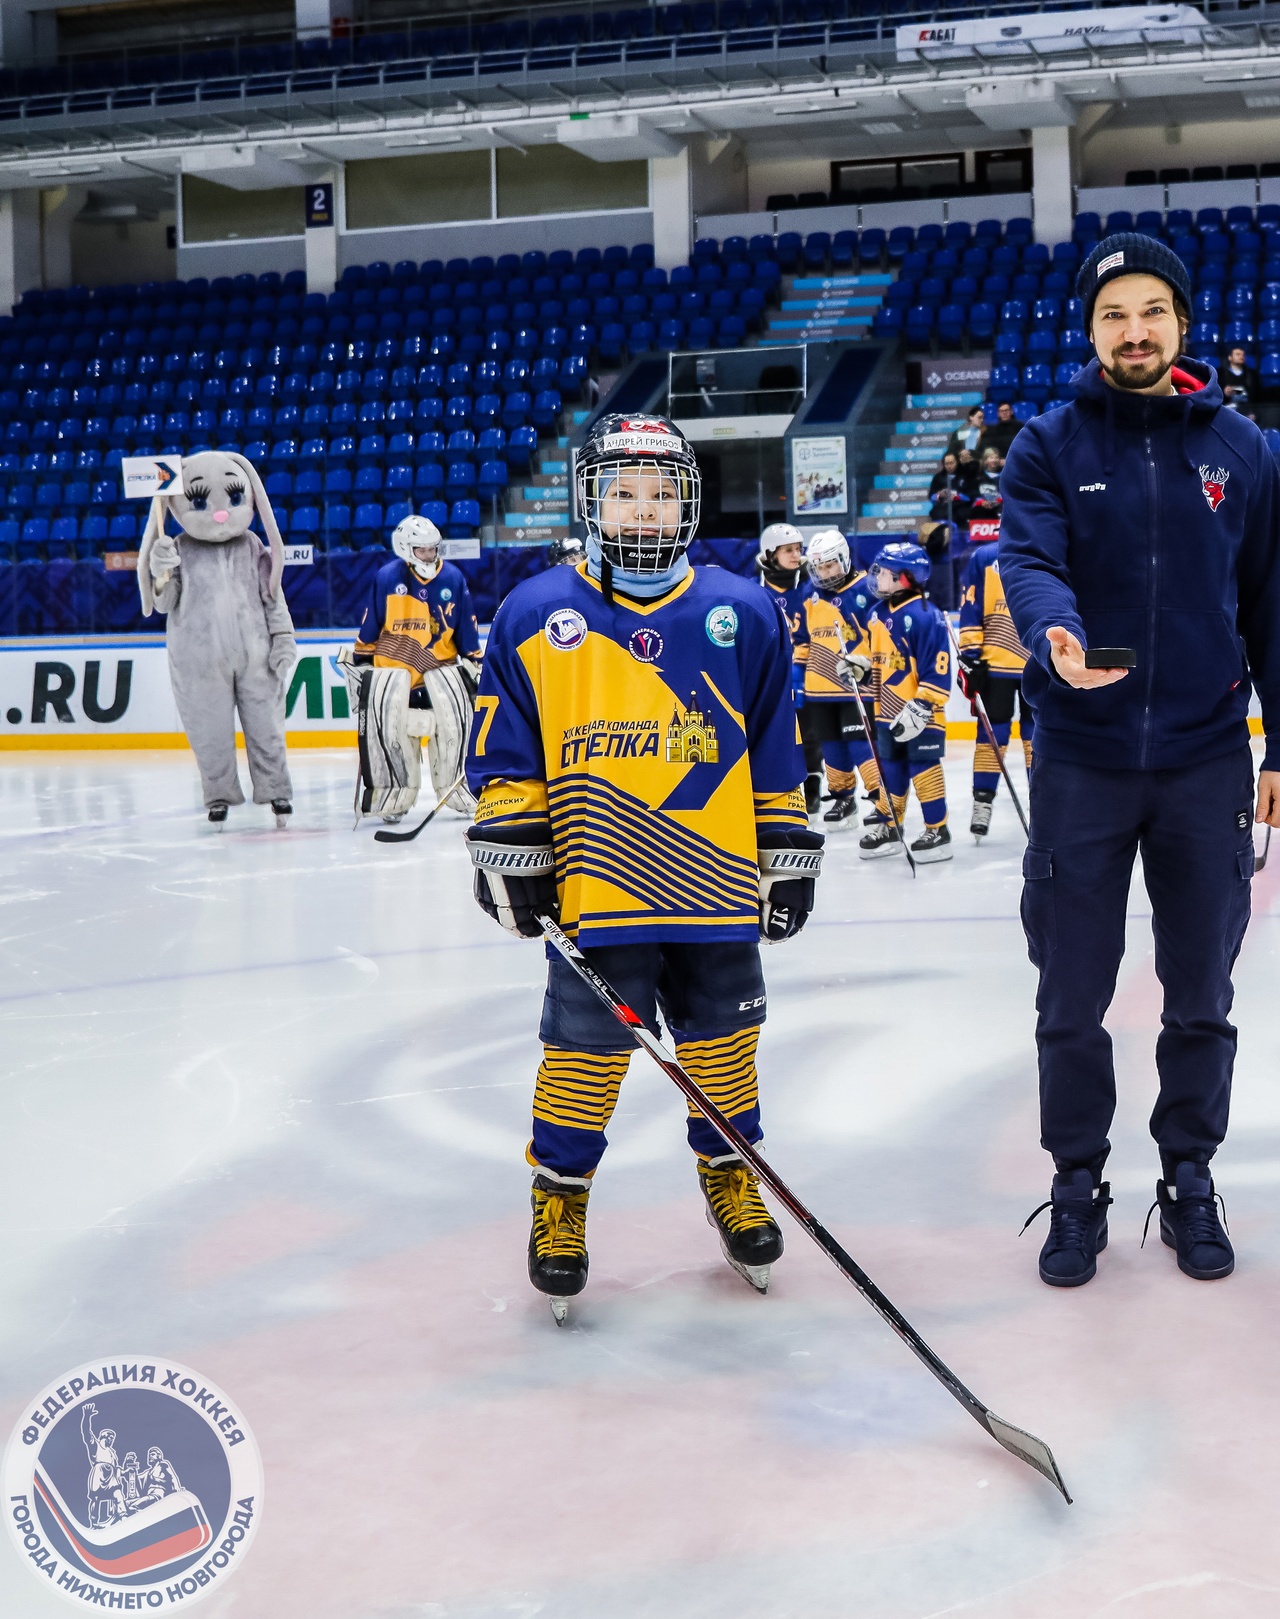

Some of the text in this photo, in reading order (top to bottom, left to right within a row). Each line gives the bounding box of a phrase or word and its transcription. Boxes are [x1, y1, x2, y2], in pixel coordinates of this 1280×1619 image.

[929, 28, 957, 41] AGAT
[1064, 25, 1107, 35] HAVAL
[313, 188, 326, 211] 2
[944, 370, 990, 381] OCEANIS
[606, 436, 643, 448] АНДРЕЙ
[935, 650, 949, 675] 8
[474, 695, 500, 757] 7
[607, 720, 659, 731] КОМАНДА
